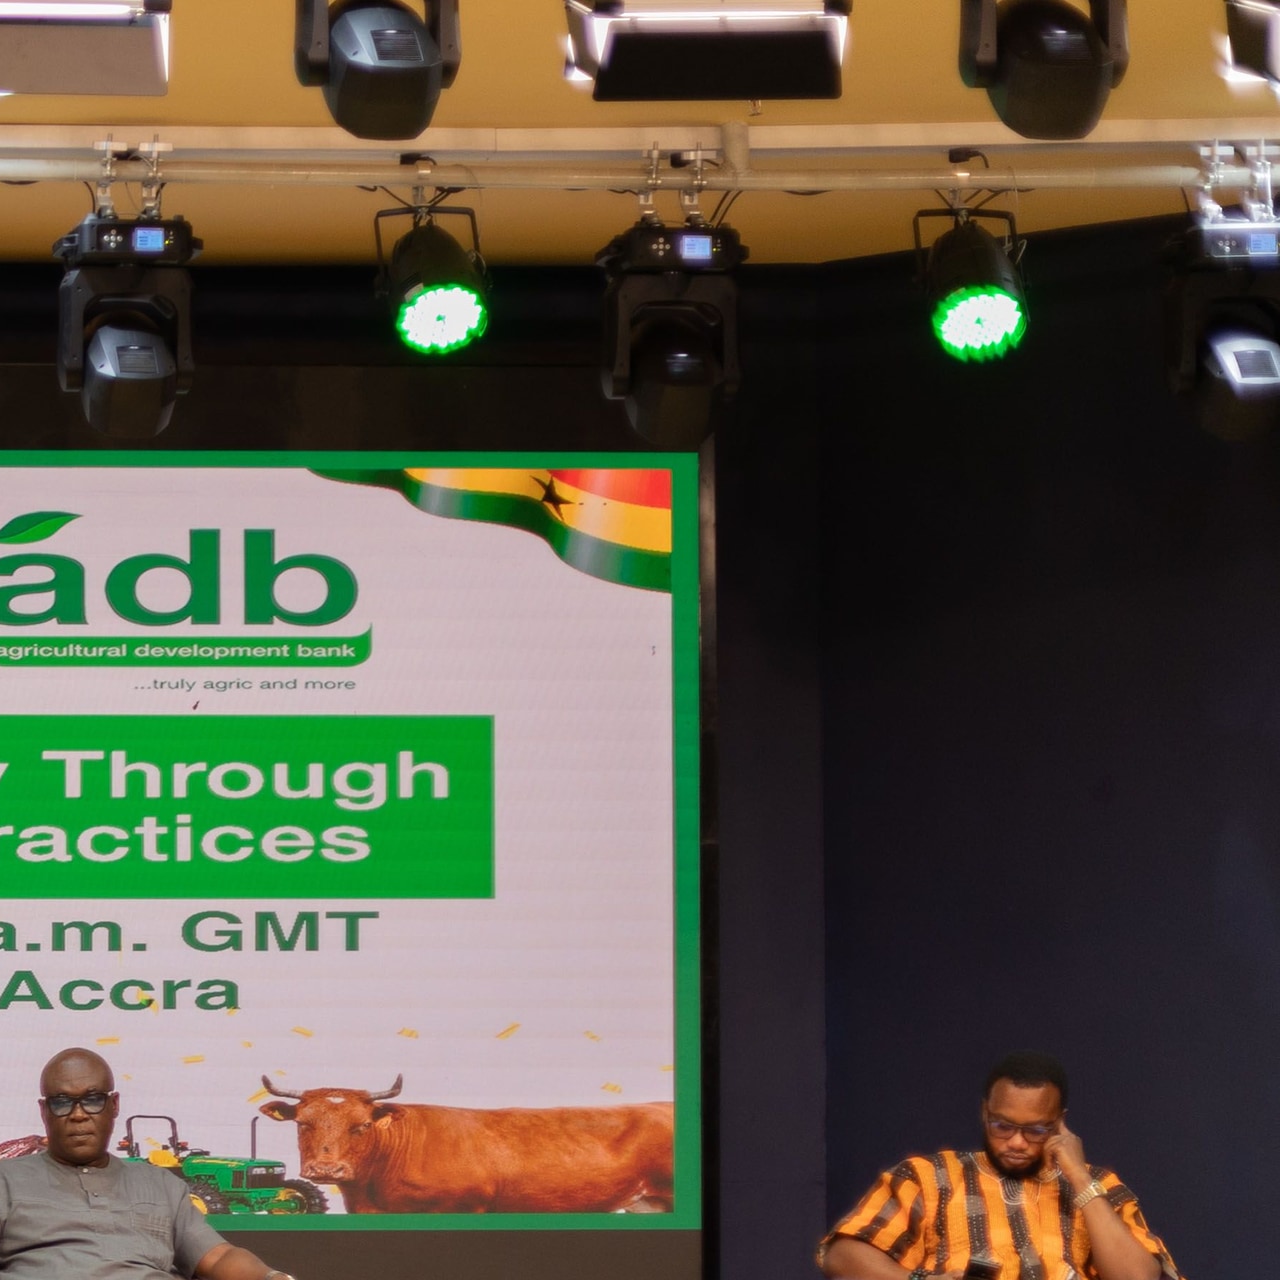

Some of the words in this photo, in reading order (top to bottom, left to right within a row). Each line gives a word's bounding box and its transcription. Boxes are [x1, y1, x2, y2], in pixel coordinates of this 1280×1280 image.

[134, 643, 290, 660] development
[297, 643, 356, 658] bank
[203, 678, 253, 693] agric
[260, 678, 298, 690] and
[304, 680, 357, 690] more
[41, 750, 450, 811] Through
[181, 910, 379, 953] GMT
